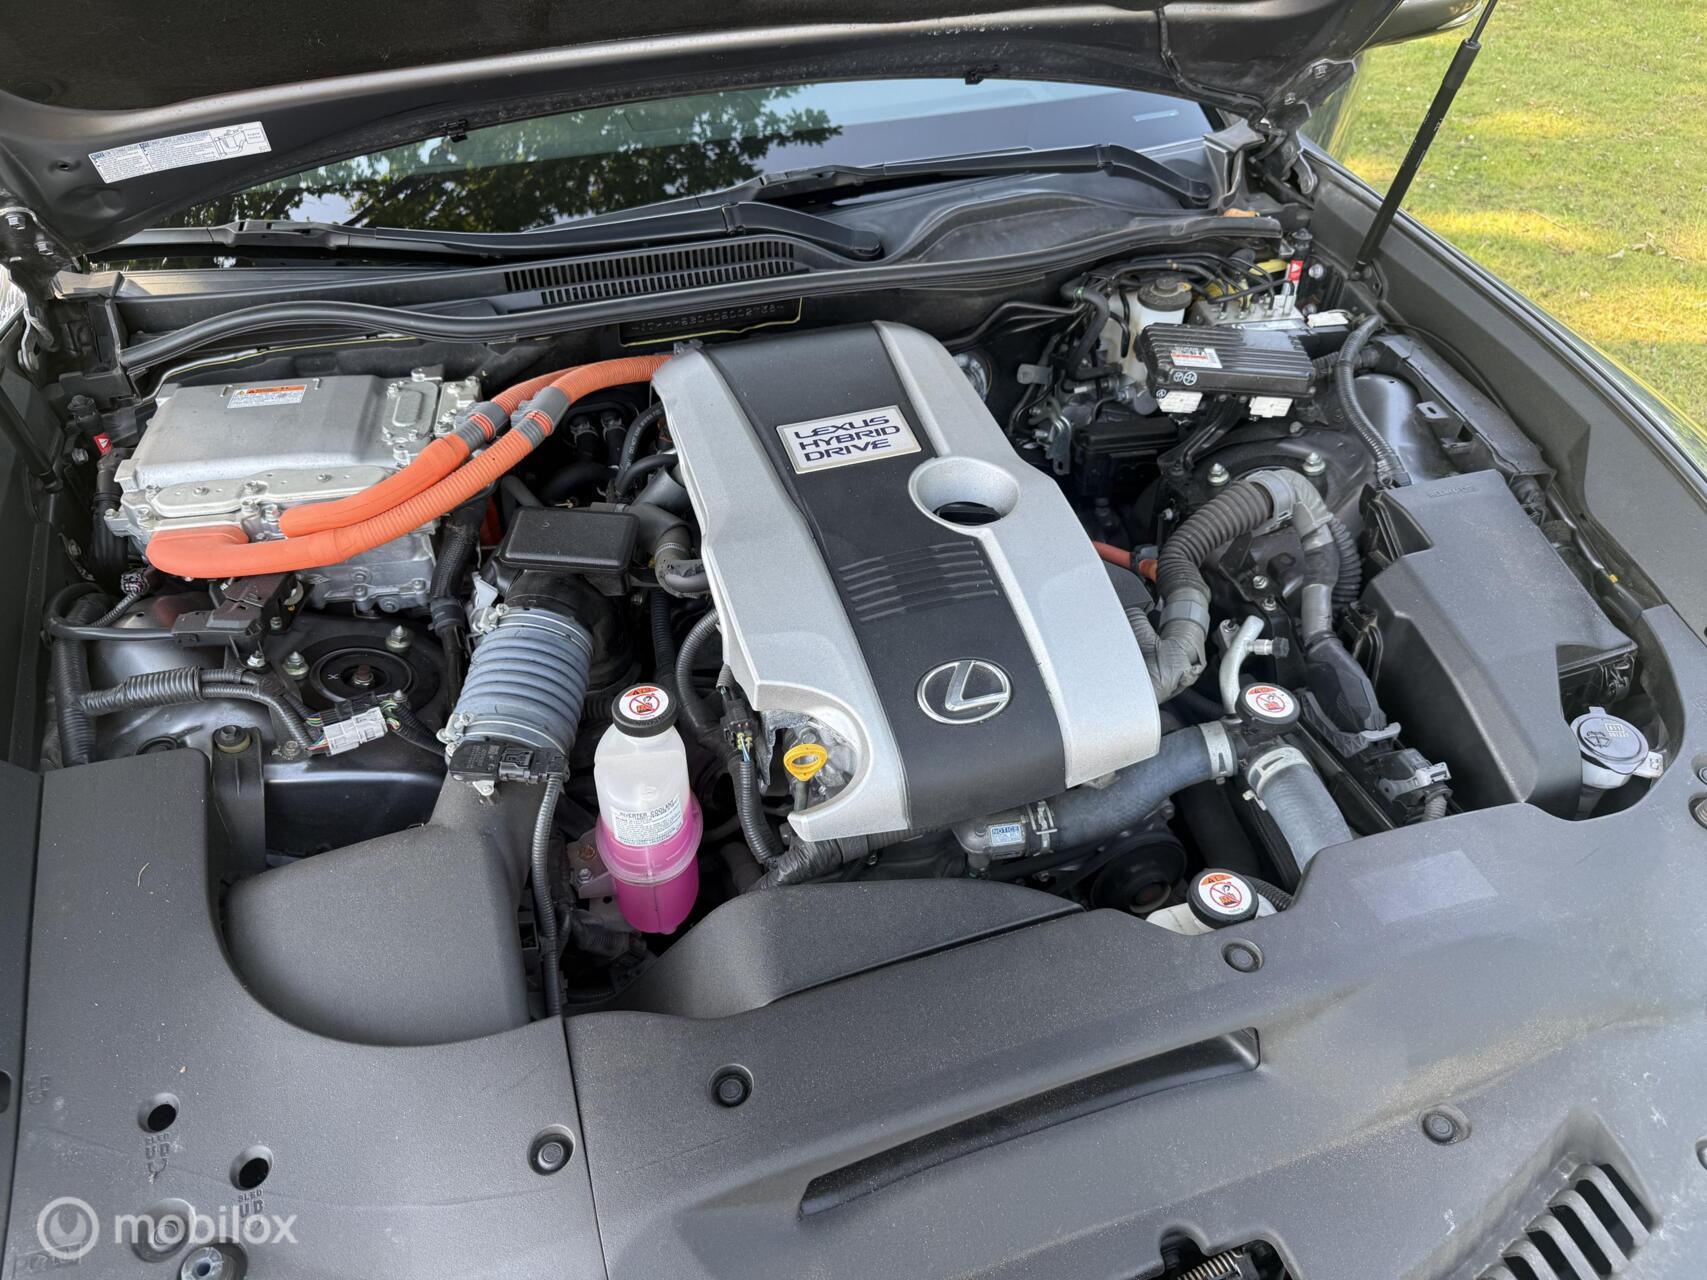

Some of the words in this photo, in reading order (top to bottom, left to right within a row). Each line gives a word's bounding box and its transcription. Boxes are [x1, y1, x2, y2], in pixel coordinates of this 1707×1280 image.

[794, 416, 889, 439] LEXUS
[798, 425, 900, 451] HYBRID
[804, 438, 890, 462] DRIVE
[650, 800, 675, 817] COOLANT
[992, 826, 1019, 834] NOTICE
